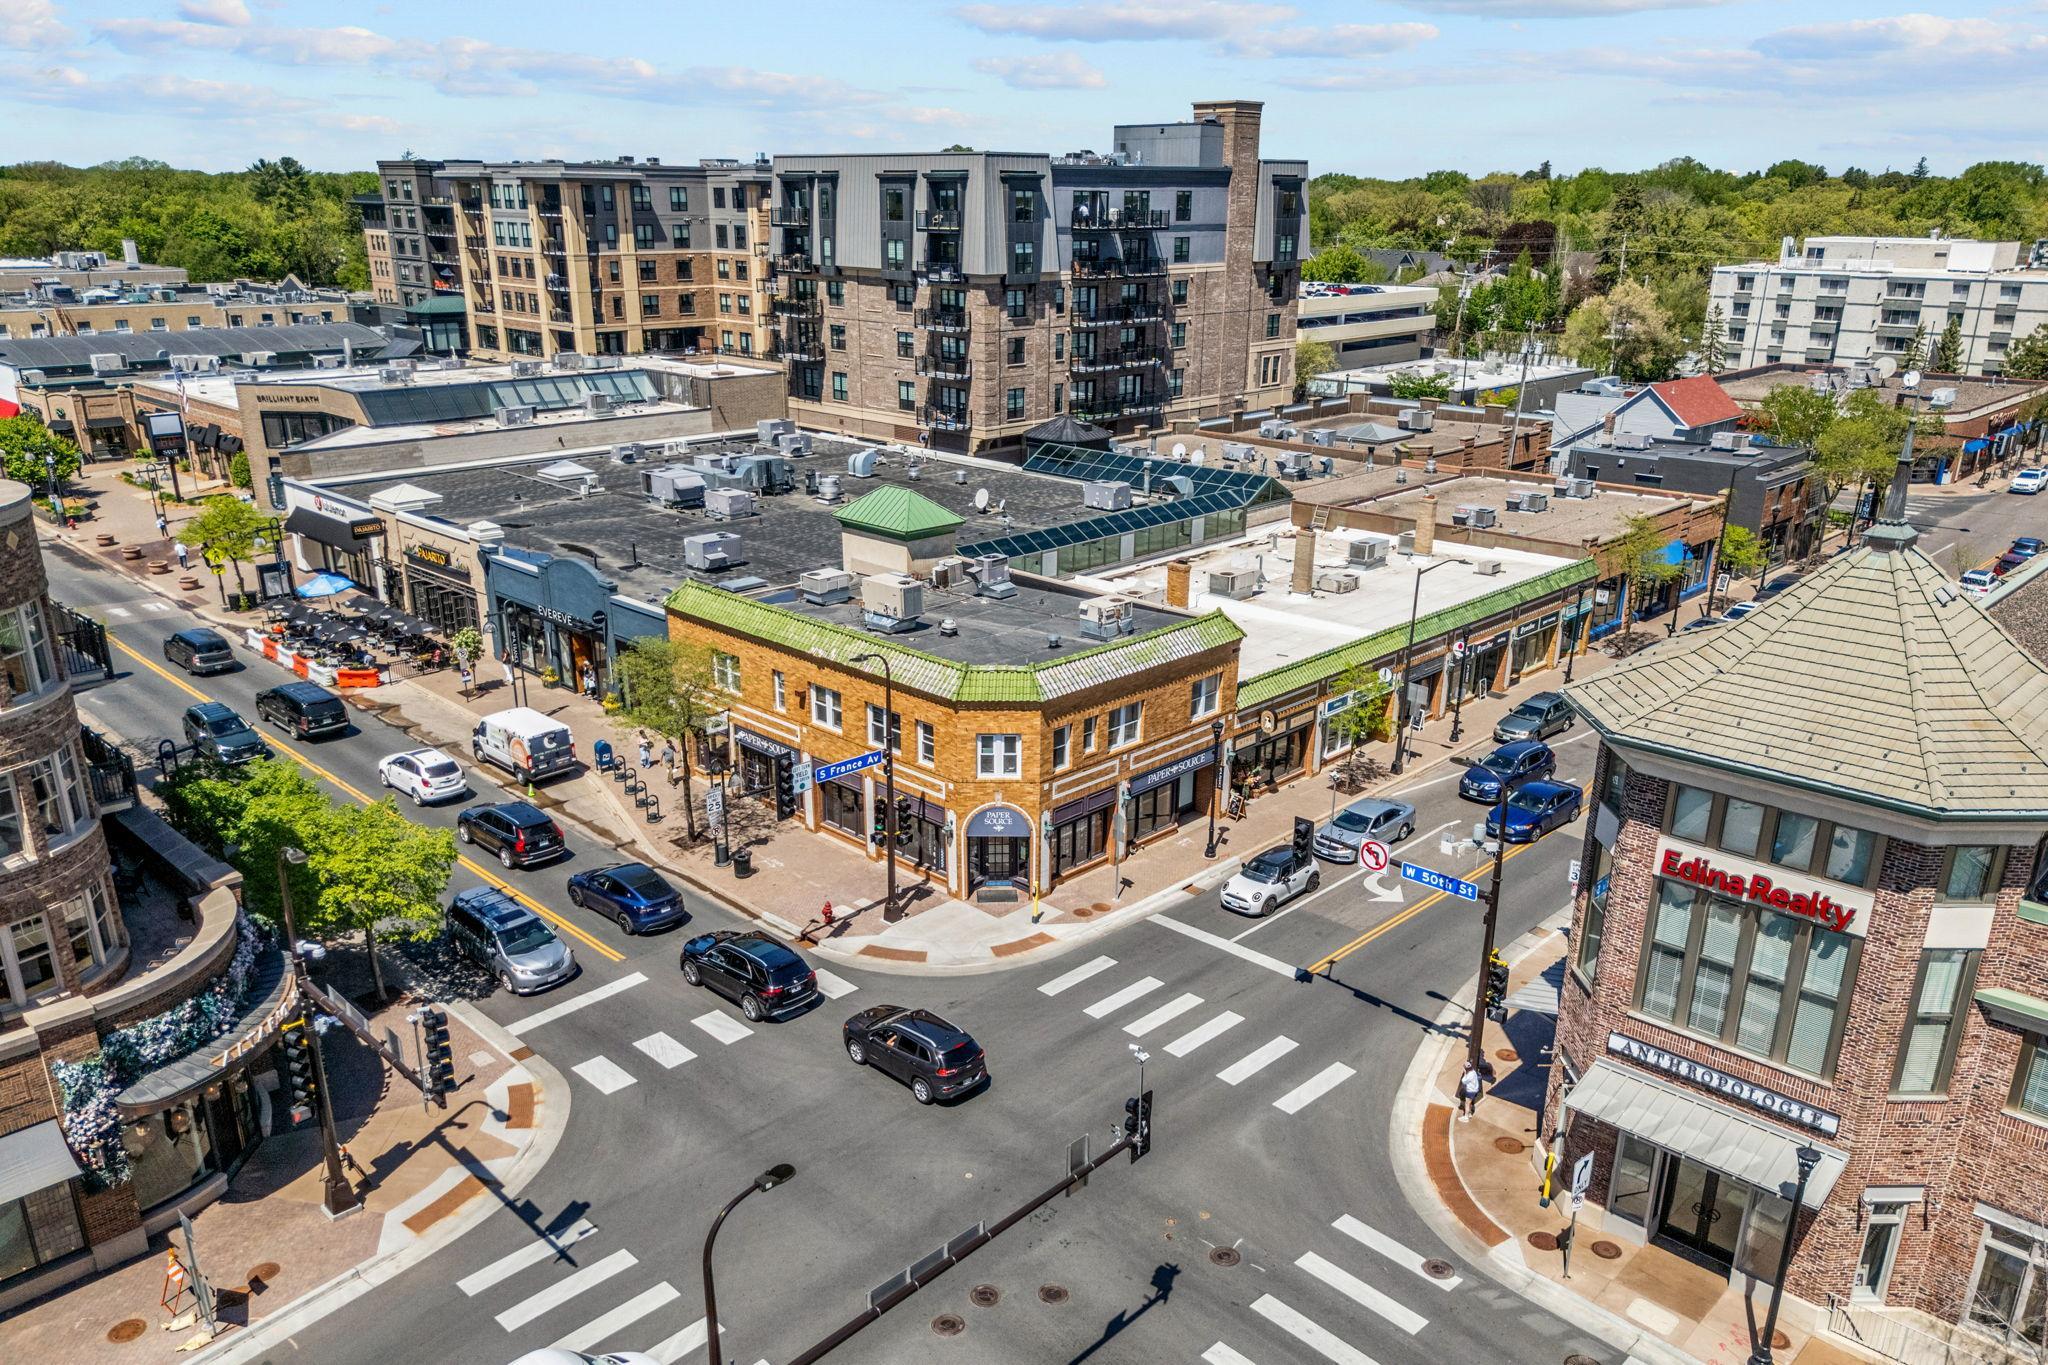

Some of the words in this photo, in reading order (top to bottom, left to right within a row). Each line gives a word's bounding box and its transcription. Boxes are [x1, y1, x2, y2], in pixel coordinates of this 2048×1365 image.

[257, 395, 294, 403] BRILLIANT
[538, 605, 573, 626] EVEREVE
[820, 770, 826, 779] S
[830, 761, 863, 776] France
[867, 755, 879, 765] Av
[1147, 768, 1171, 784] PAPER
[1178, 753, 1206, 772] SOURCE
[708, 801, 721, 812] 25
[1406, 866, 1416, 878] W
[1422, 872, 1452, 890] 50th
[1458, 884, 1473, 897] St
[1660, 849, 1746, 897] Edina
[1748, 874, 1858, 932] Realty
[1620, 1040, 1824, 1128] ANTHROPOLOGIE
